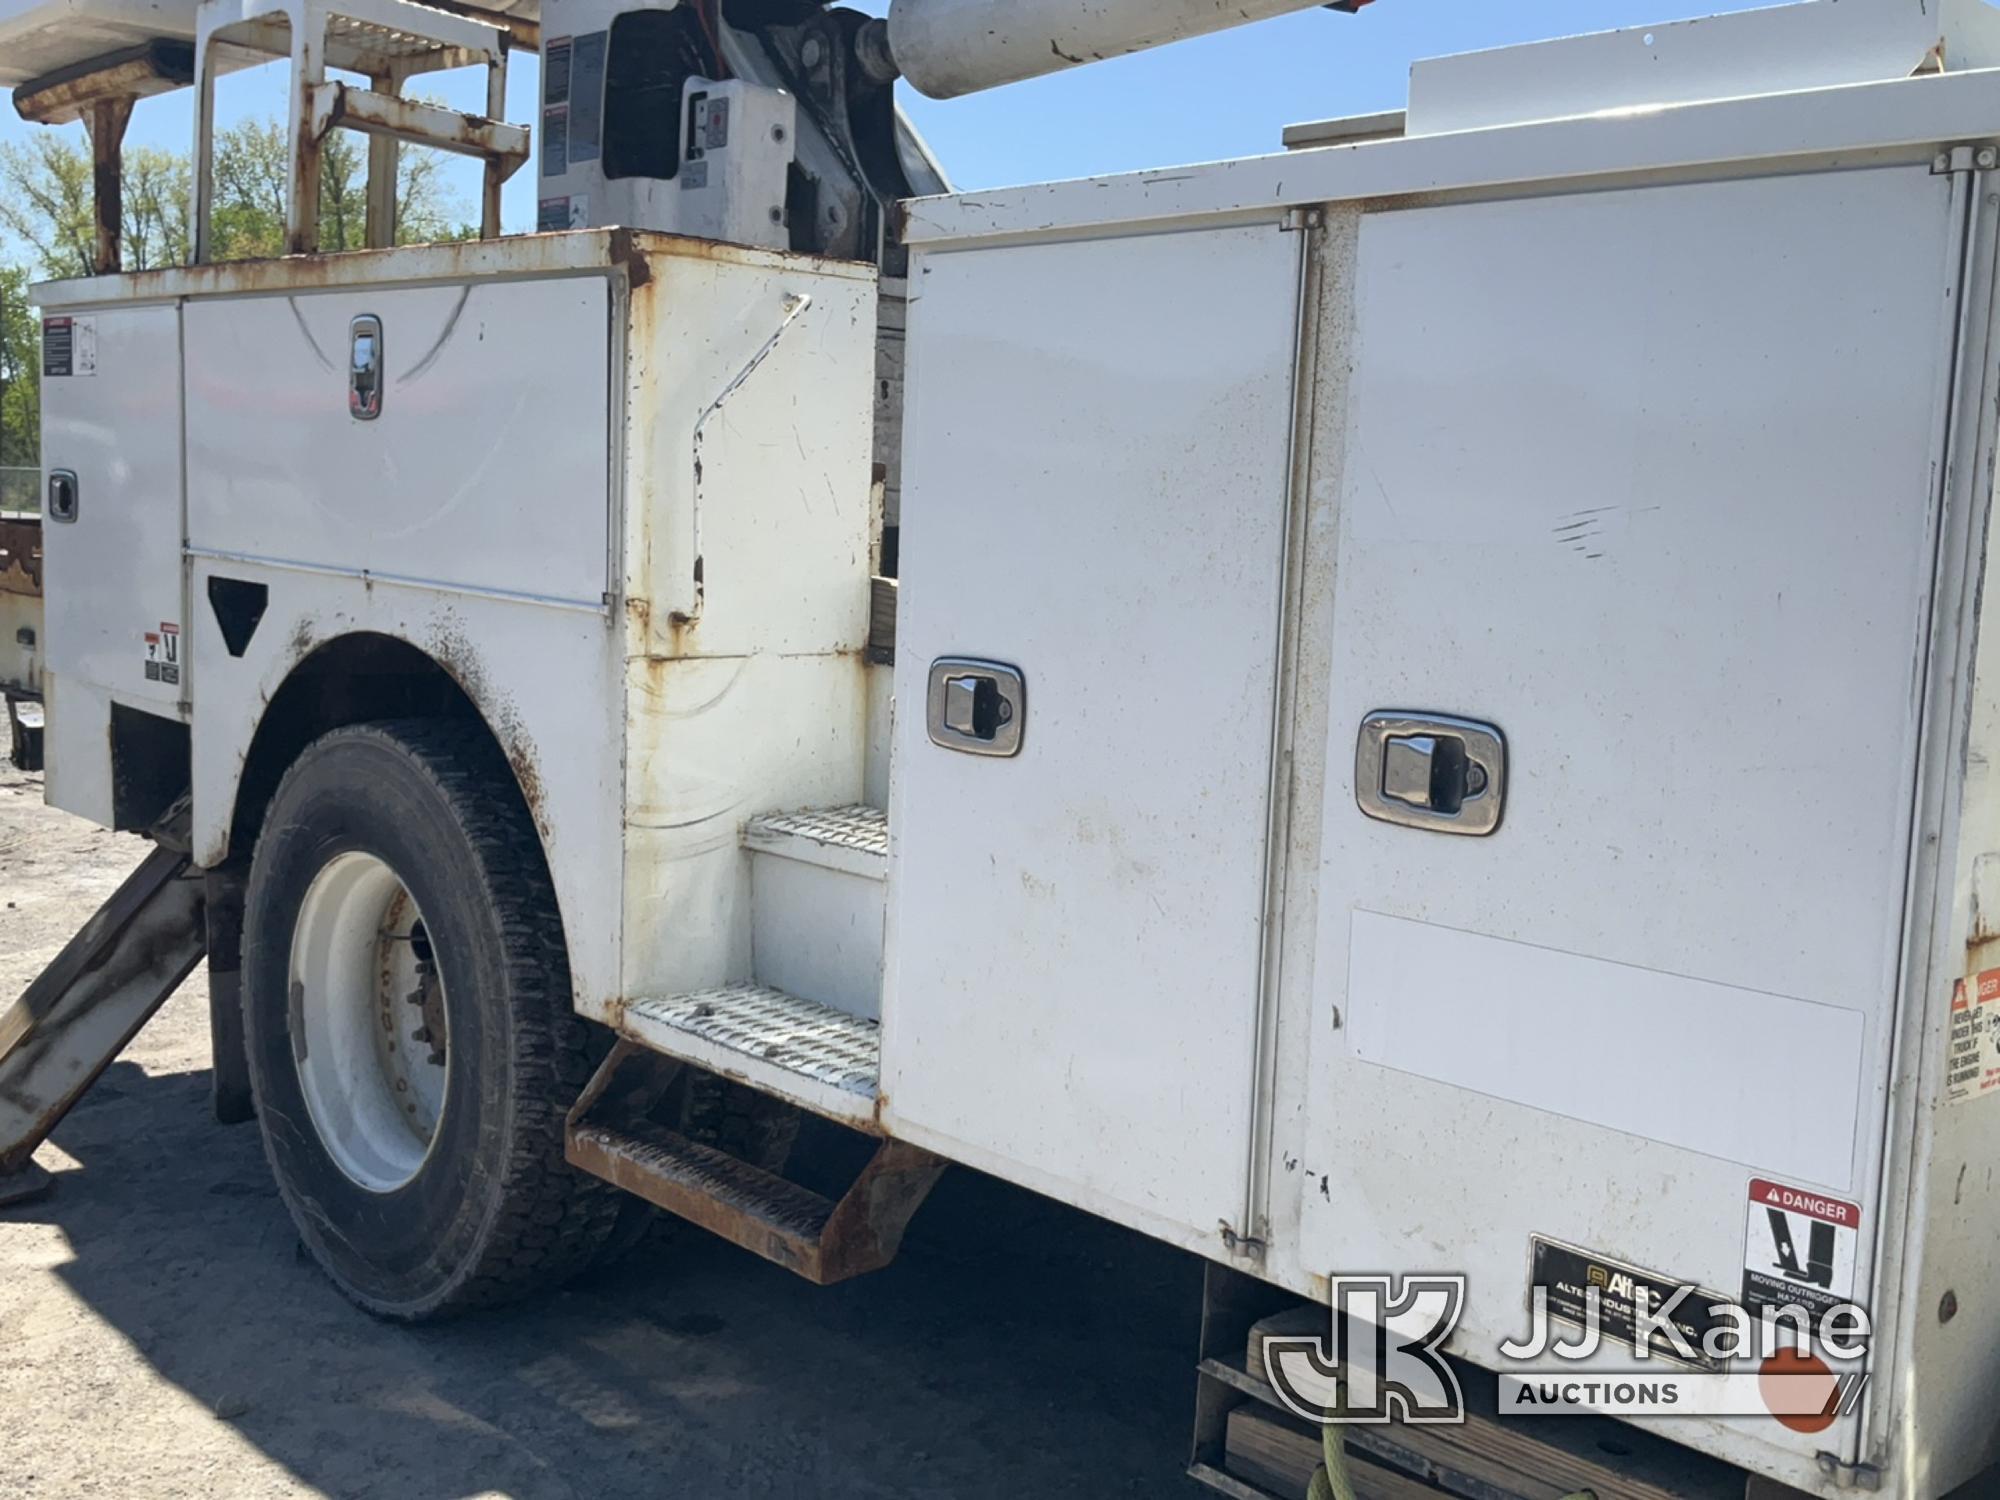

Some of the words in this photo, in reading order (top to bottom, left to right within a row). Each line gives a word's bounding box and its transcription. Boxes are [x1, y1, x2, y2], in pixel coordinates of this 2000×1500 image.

[1783, 1192, 1847, 1221] DANGER
[1556, 1282, 1593, 1301] ALTEC
[1607, 1272, 1662, 1309] Altec
[1750, 1273, 1785, 1291] MOVING
[1777, 1293, 1815, 1309] HAZARD
